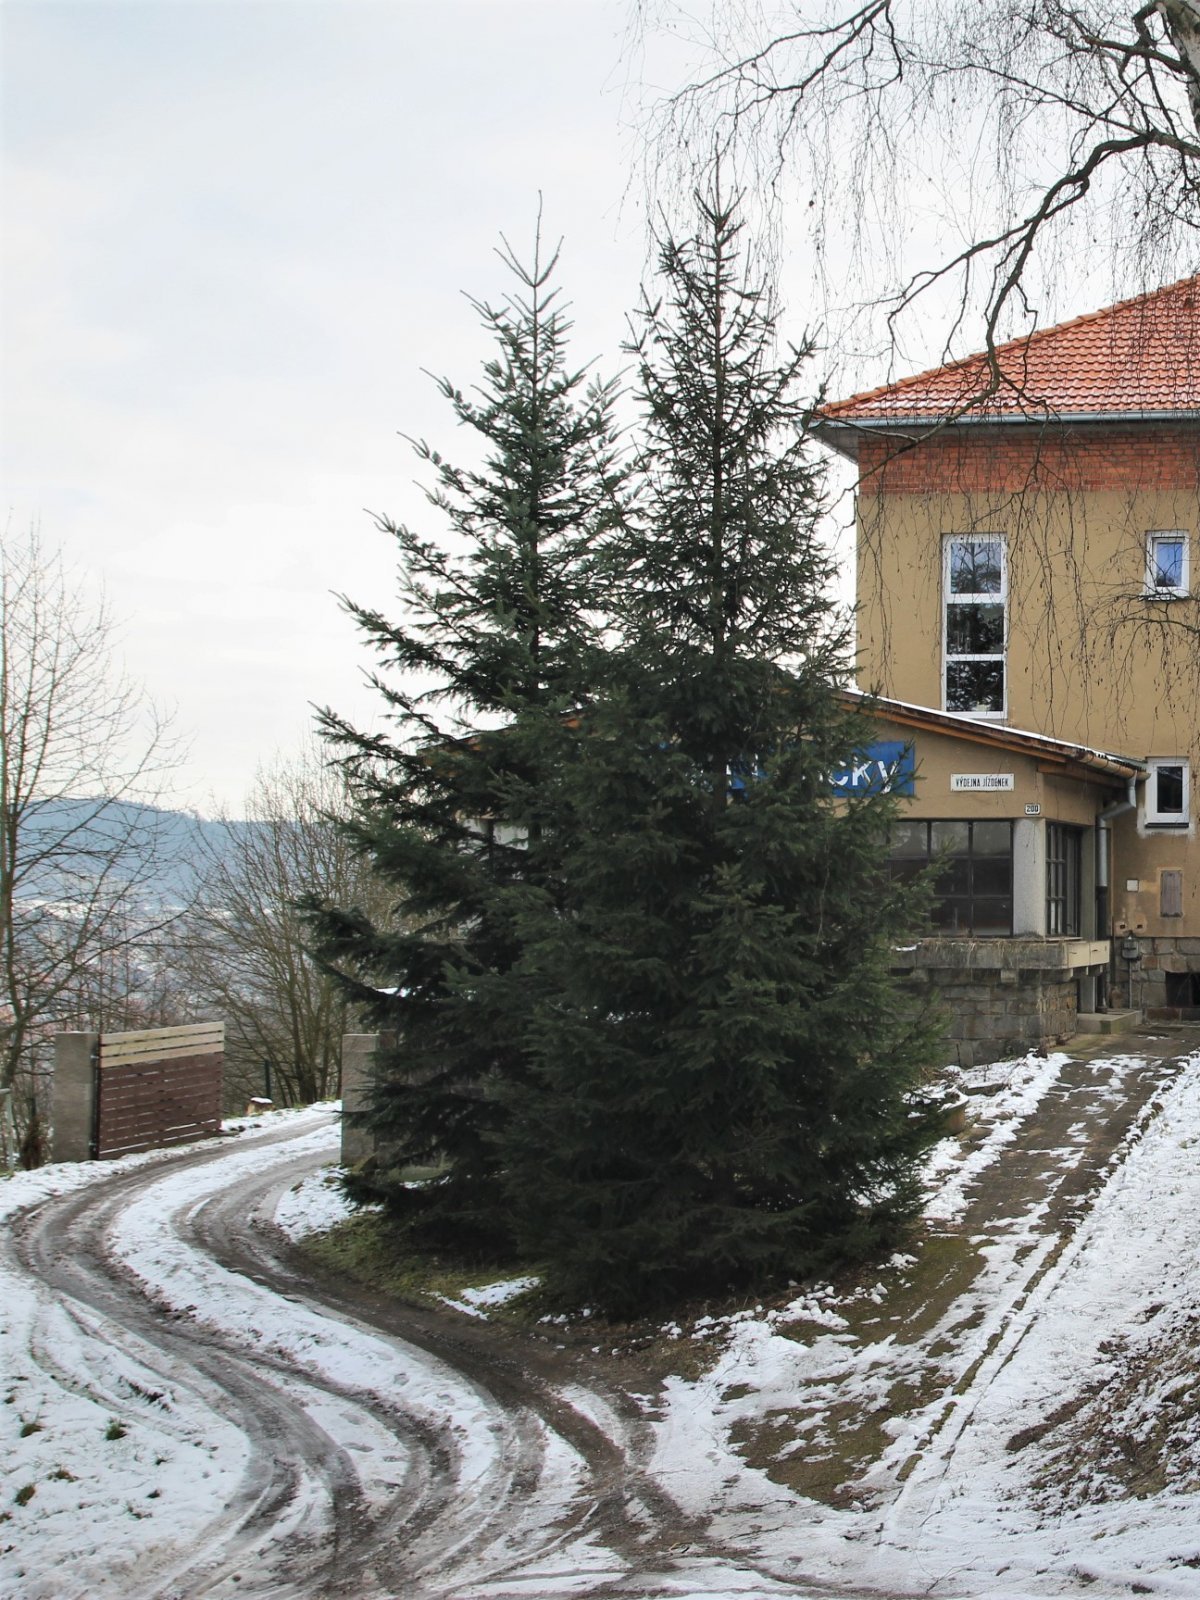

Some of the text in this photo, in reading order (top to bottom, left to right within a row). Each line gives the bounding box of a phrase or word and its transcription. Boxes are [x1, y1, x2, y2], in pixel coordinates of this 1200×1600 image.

[955, 776, 1009, 788] VÝDEJNA JÍZDENEK
[1026, 805, 1039, 813] 200
